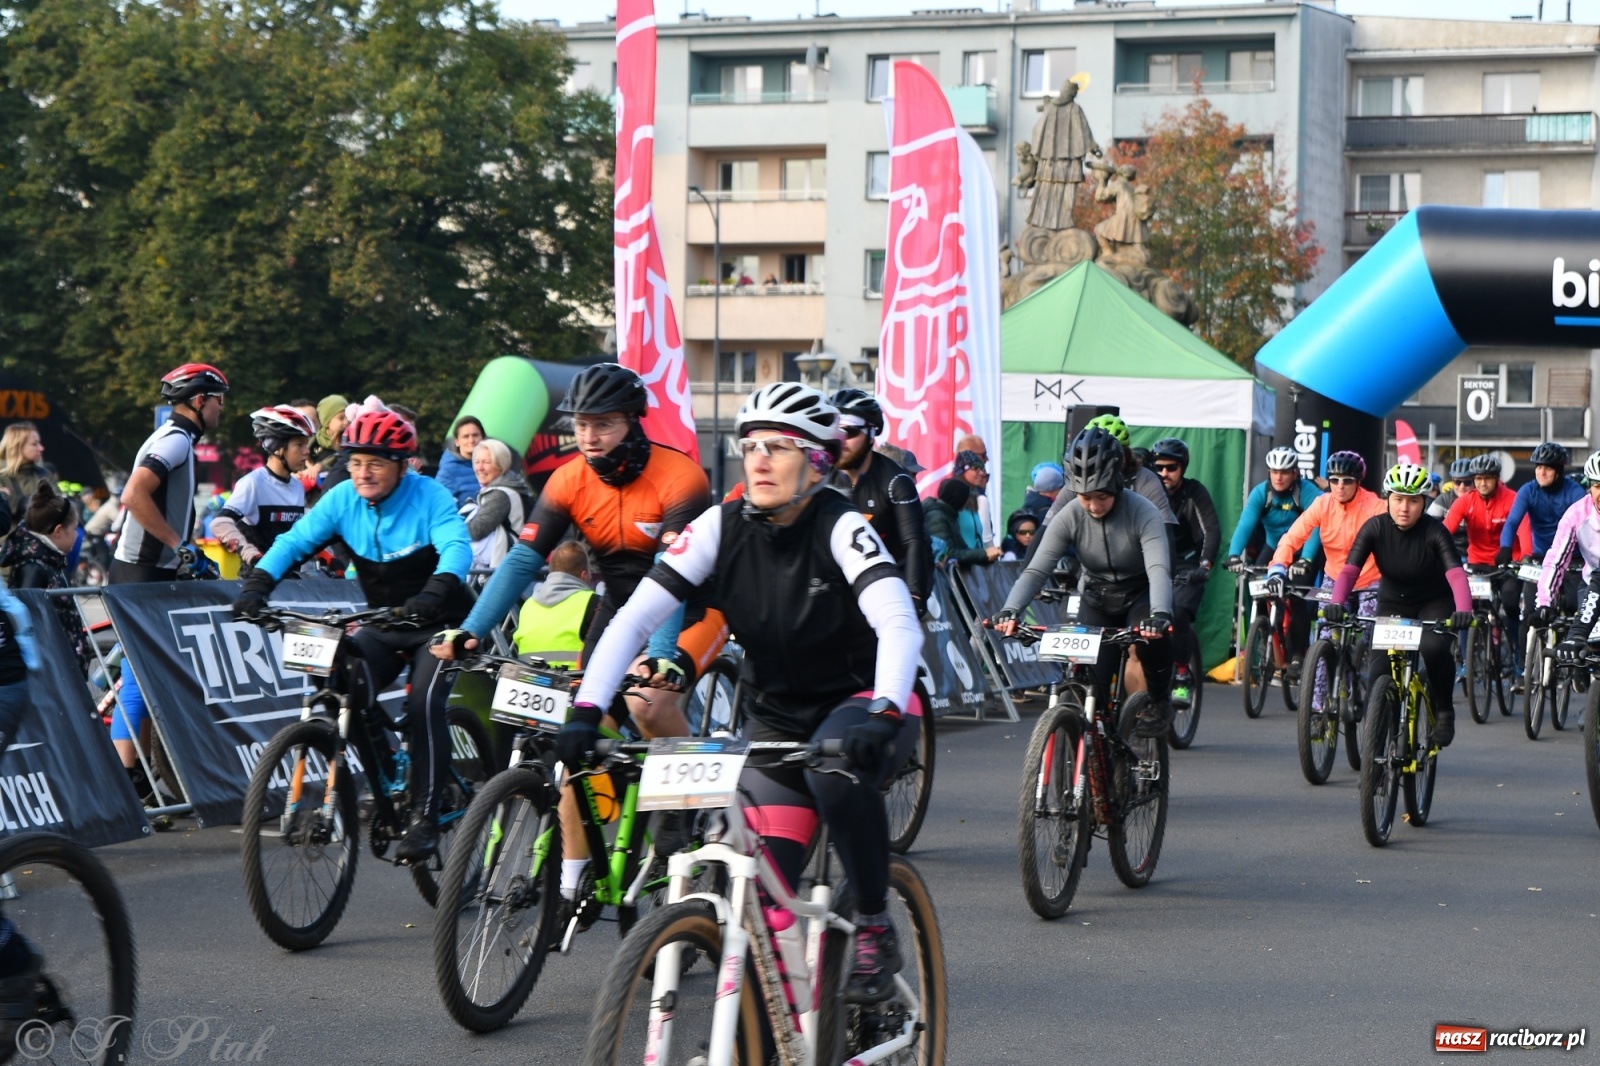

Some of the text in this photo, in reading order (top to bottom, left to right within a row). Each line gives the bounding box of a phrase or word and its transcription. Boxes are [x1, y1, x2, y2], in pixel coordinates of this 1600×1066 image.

[1552, 257, 1600, 308] bi
[1463, 381, 1494, 389] SEKTOR
[1466, 389, 1490, 421] 0
[1471, 584, 1485, 593] 195
[1052, 637, 1090, 650] 2980
[1383, 630, 1413, 640] 3241
[507, 688, 555, 714] 2380
[660, 761, 723, 785] 1903
